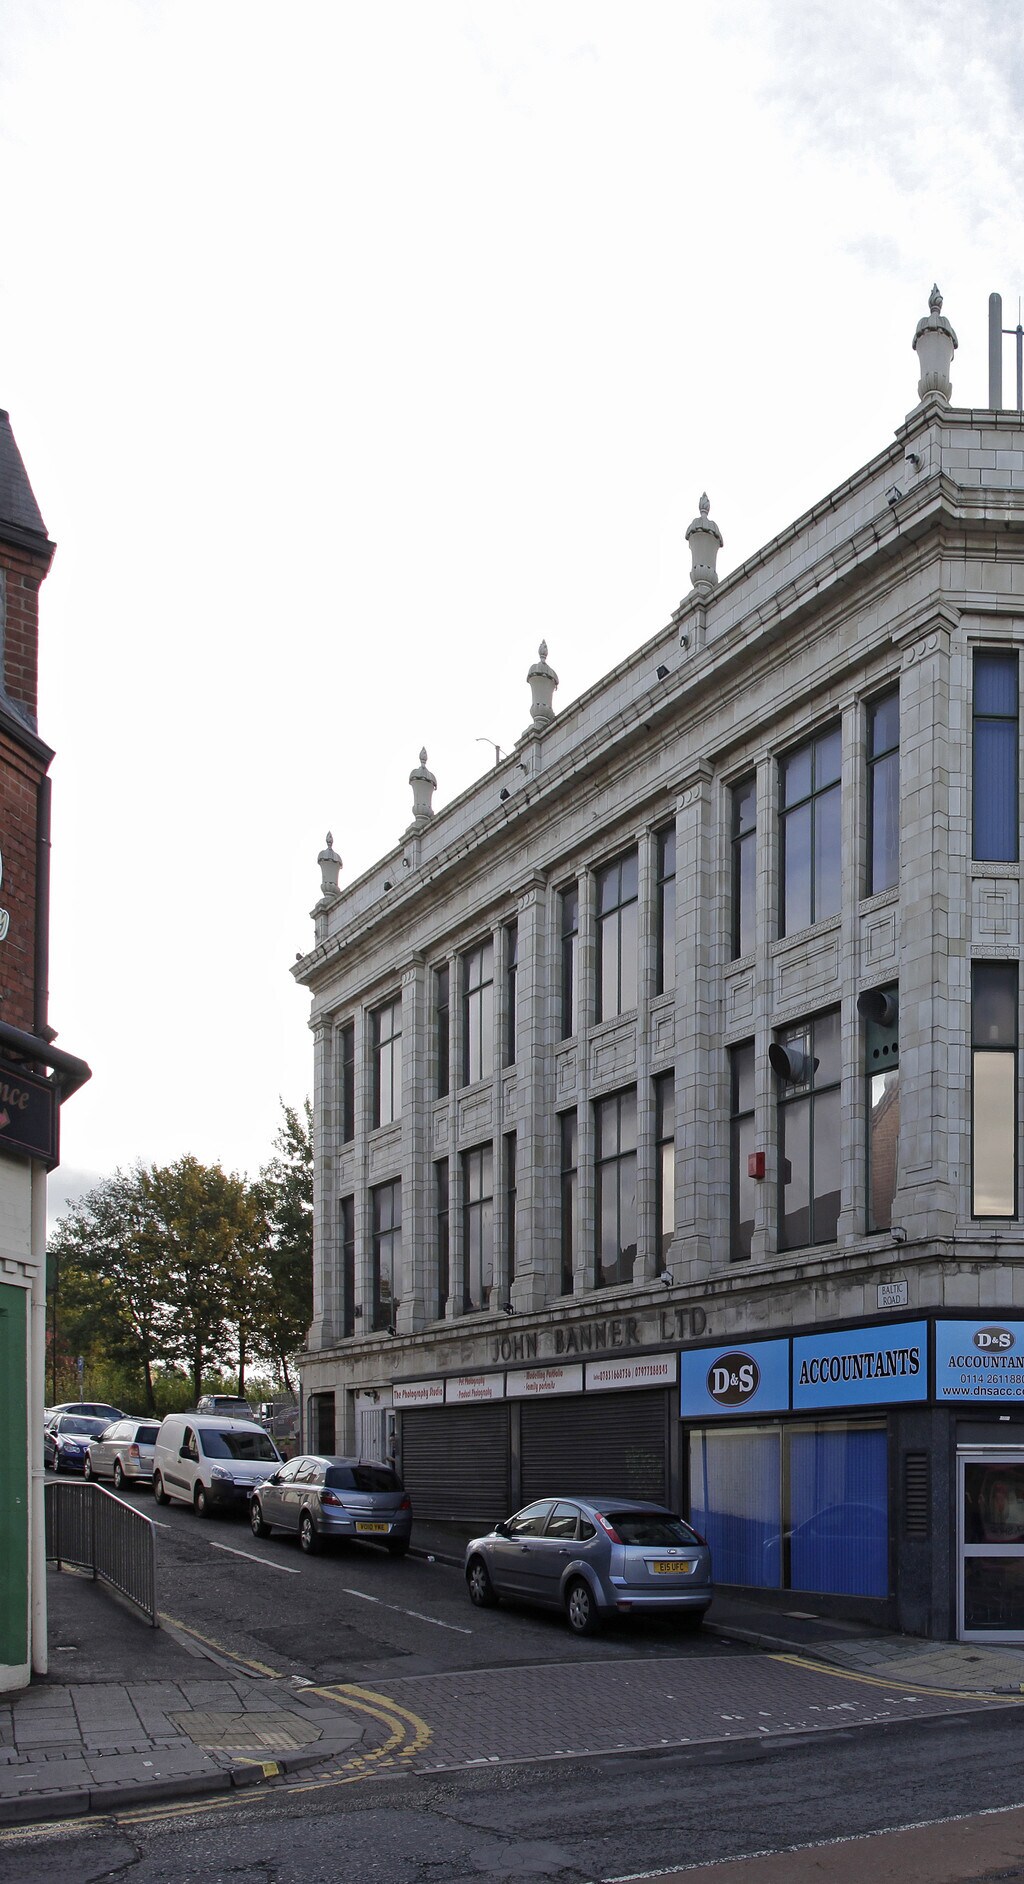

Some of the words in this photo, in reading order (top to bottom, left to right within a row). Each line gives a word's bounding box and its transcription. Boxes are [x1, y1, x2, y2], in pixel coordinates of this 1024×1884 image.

[881, 1283, 903, 1296] BALTIC
[883, 1295, 901, 1306] ROAD
[492, 1332, 538, 1362] JOHN
[554, 1316, 640, 1354] BANNER
[977, 1333, 1011, 1348] D&S
[799, 1347, 920, 1385] ACCOUNTANTS
[712, 1364, 754, 1394] D&S
[960, 1374, 984, 1384] 0114
